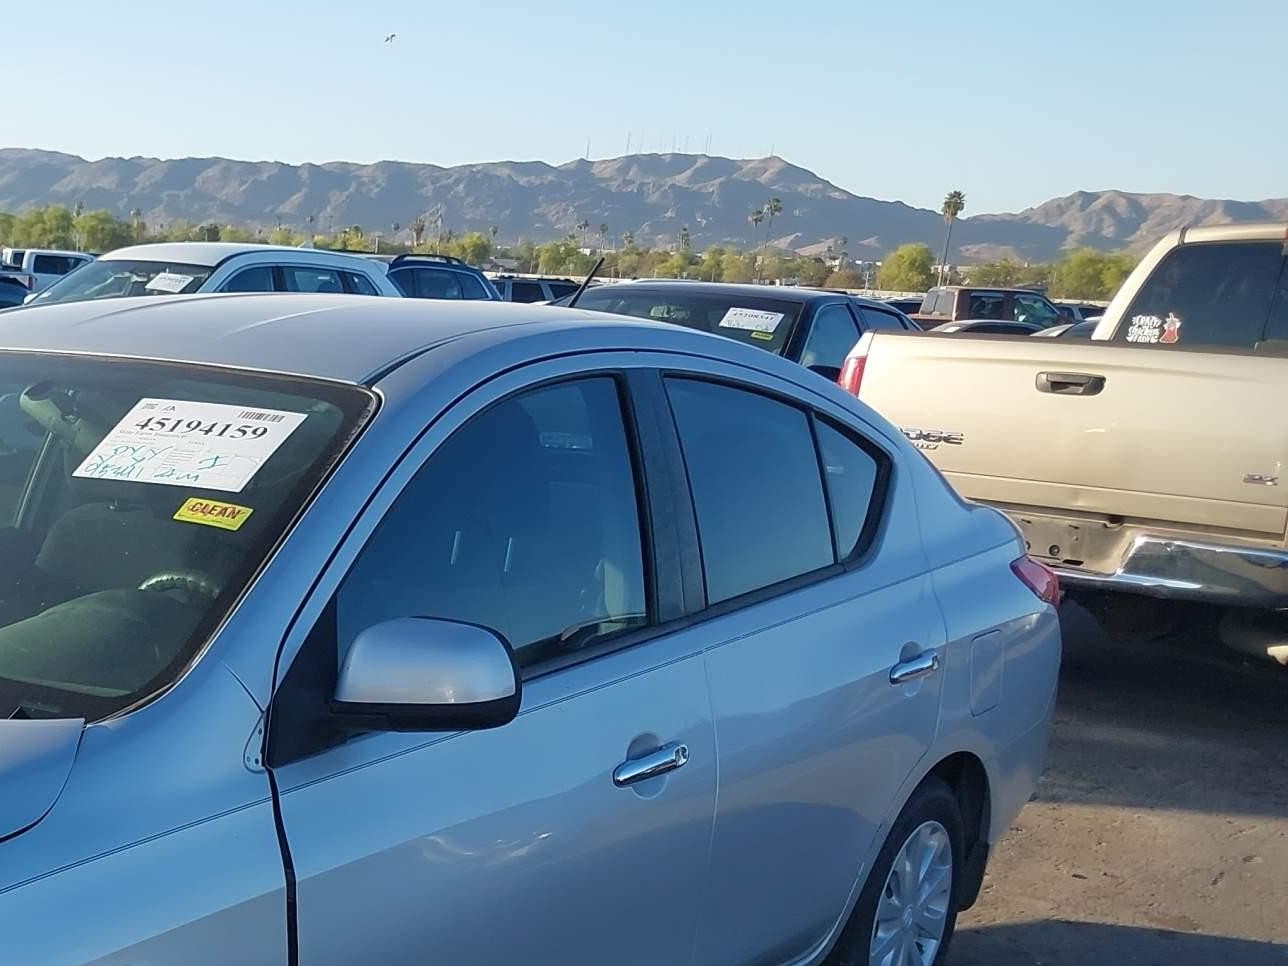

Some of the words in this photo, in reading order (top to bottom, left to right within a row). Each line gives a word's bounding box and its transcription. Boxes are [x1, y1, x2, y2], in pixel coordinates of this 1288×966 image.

[135, 416, 269, 440] 45194159
[901, 427, 964, 445] DGE
[190, 502, 242, 519] CLEAN
